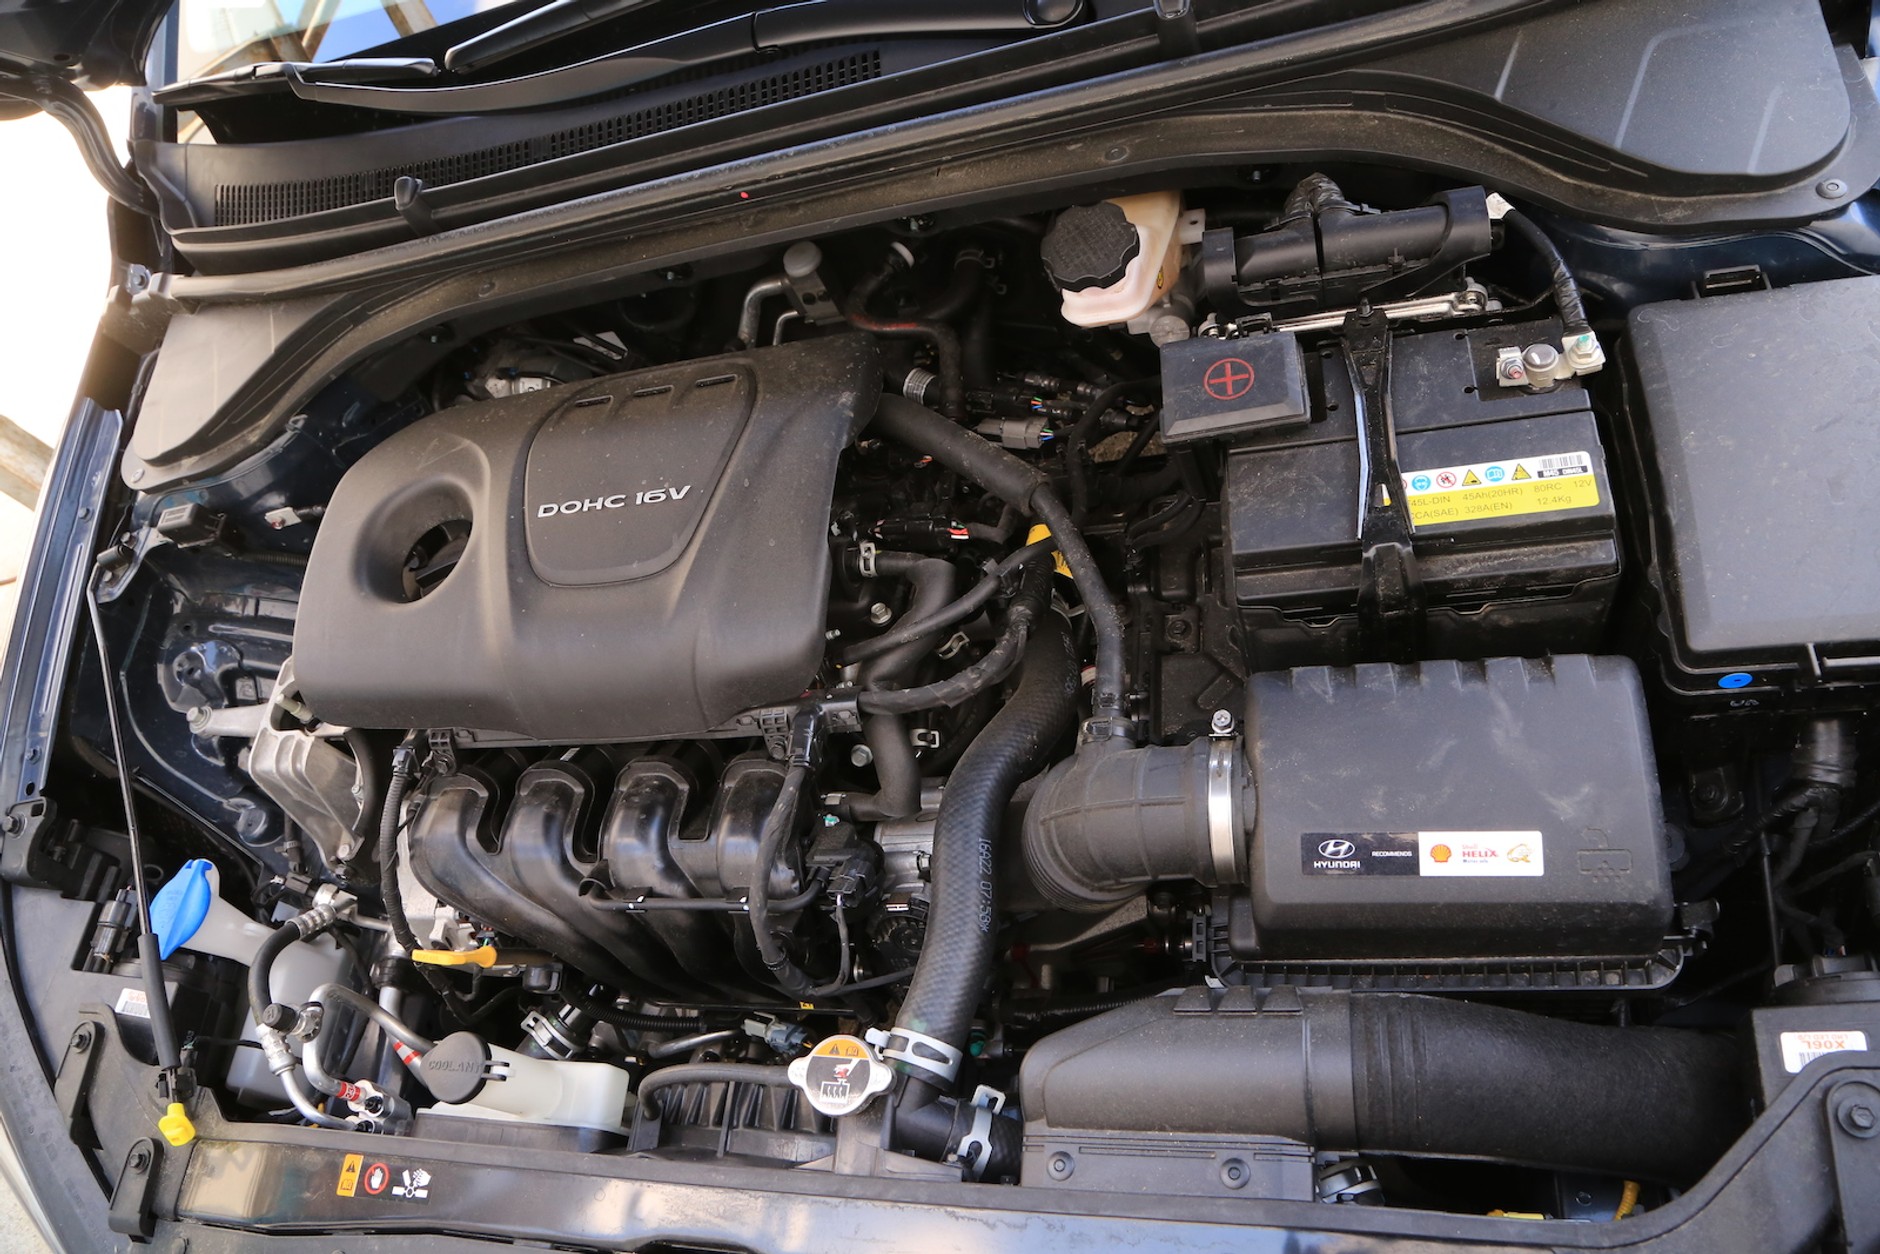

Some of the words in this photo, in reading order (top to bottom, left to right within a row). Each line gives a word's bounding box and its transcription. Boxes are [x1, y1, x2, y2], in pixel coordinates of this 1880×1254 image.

[537, 494, 627, 518] DOHC
[635, 485, 691, 505] 16V
[1409, 496, 1451, 507] 45L-DIN
[1462, 487, 1523, 501] 45Ah(20HR)
[1534, 482, 1562, 493] 80RC
[1573, 479, 1592, 488] 12V
[1465, 502, 1513, 514] 328A(EN)
[1537, 495, 1572, 506] 12.4Kg
[979, 837, 992, 875] 16A22
[1462, 848, 1498, 858] HELIX
[1313, 860, 1361, 869] HYUNDAI
[428, 1060, 482, 1074] COOLANT
